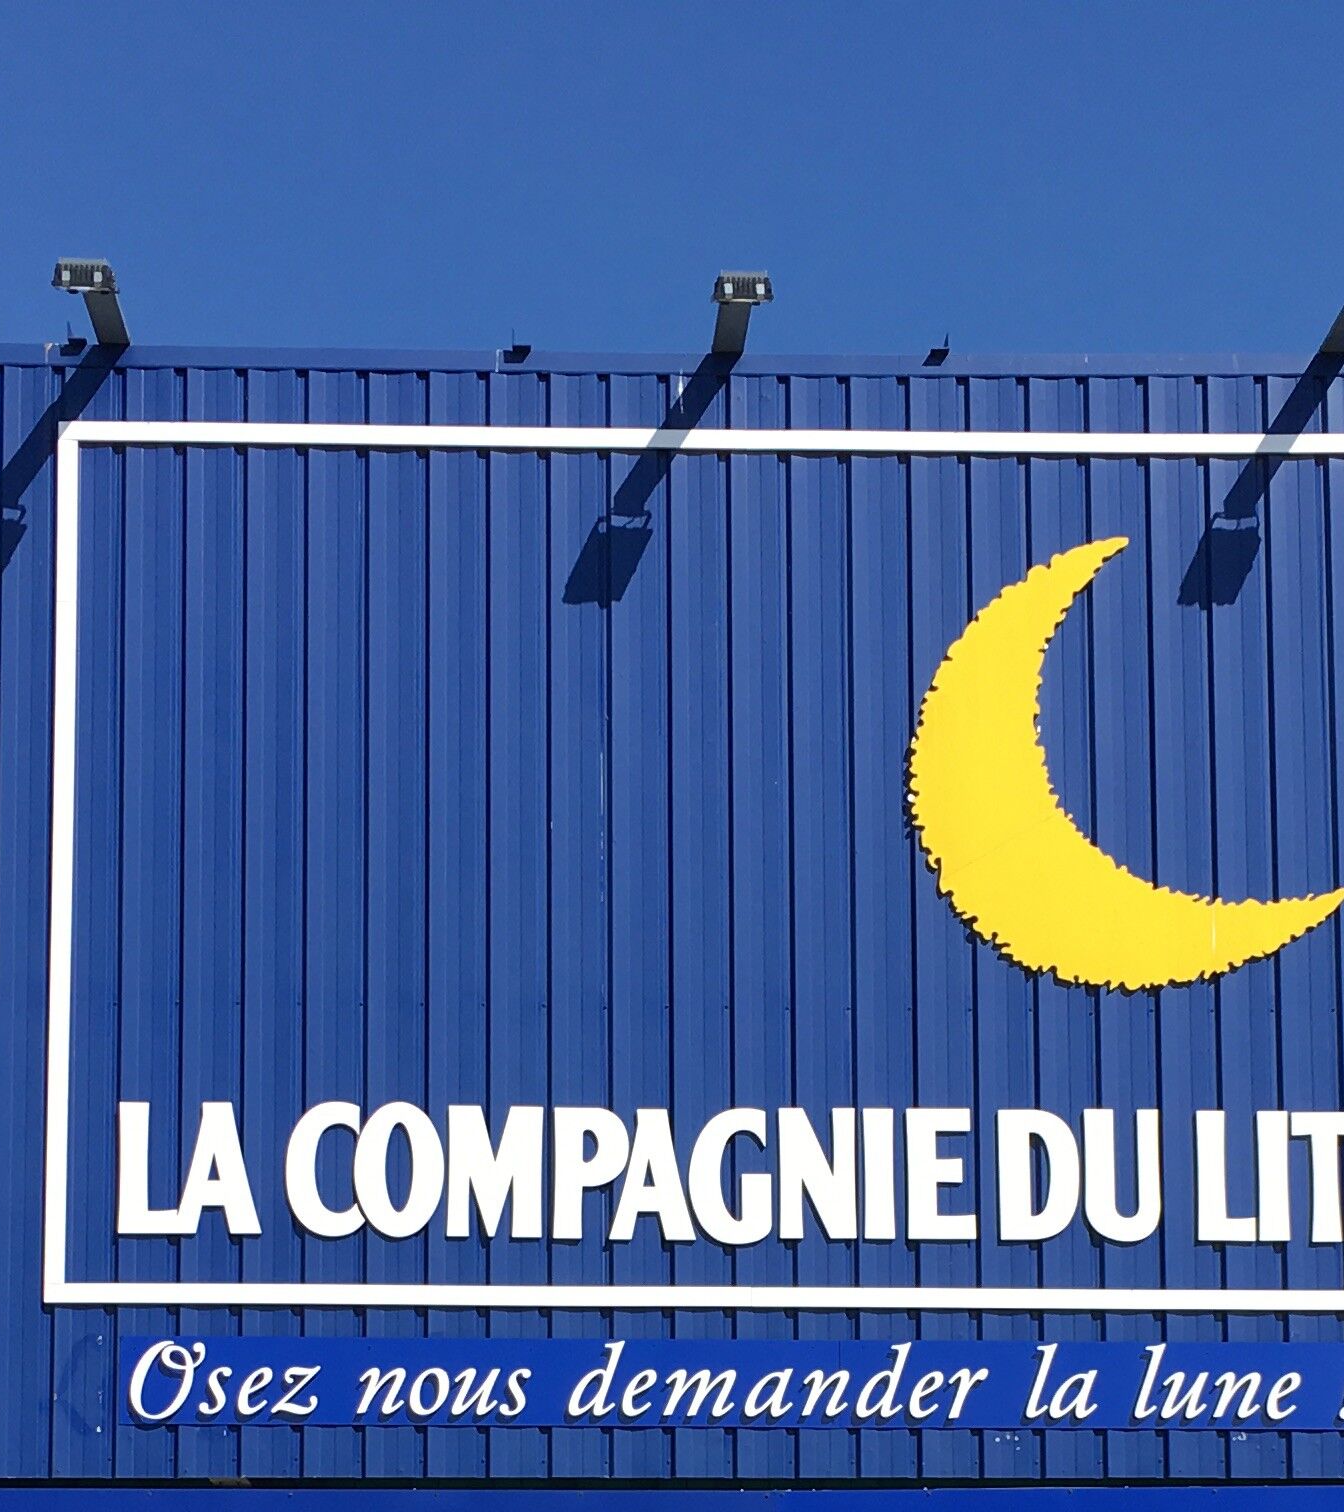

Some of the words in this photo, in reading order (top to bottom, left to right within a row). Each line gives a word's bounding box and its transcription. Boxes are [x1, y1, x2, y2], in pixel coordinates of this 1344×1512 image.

[117, 1100, 262, 1235] LA
[284, 1101, 977, 1245] COMPAGNIE
[997, 1108, 1161, 1242] DU
[358, 1364, 532, 1418] nous
[568, 1340, 989, 1420] demander
[1025, 1342, 1099, 1421] la
[1134, 1342, 1302, 1420] lune
